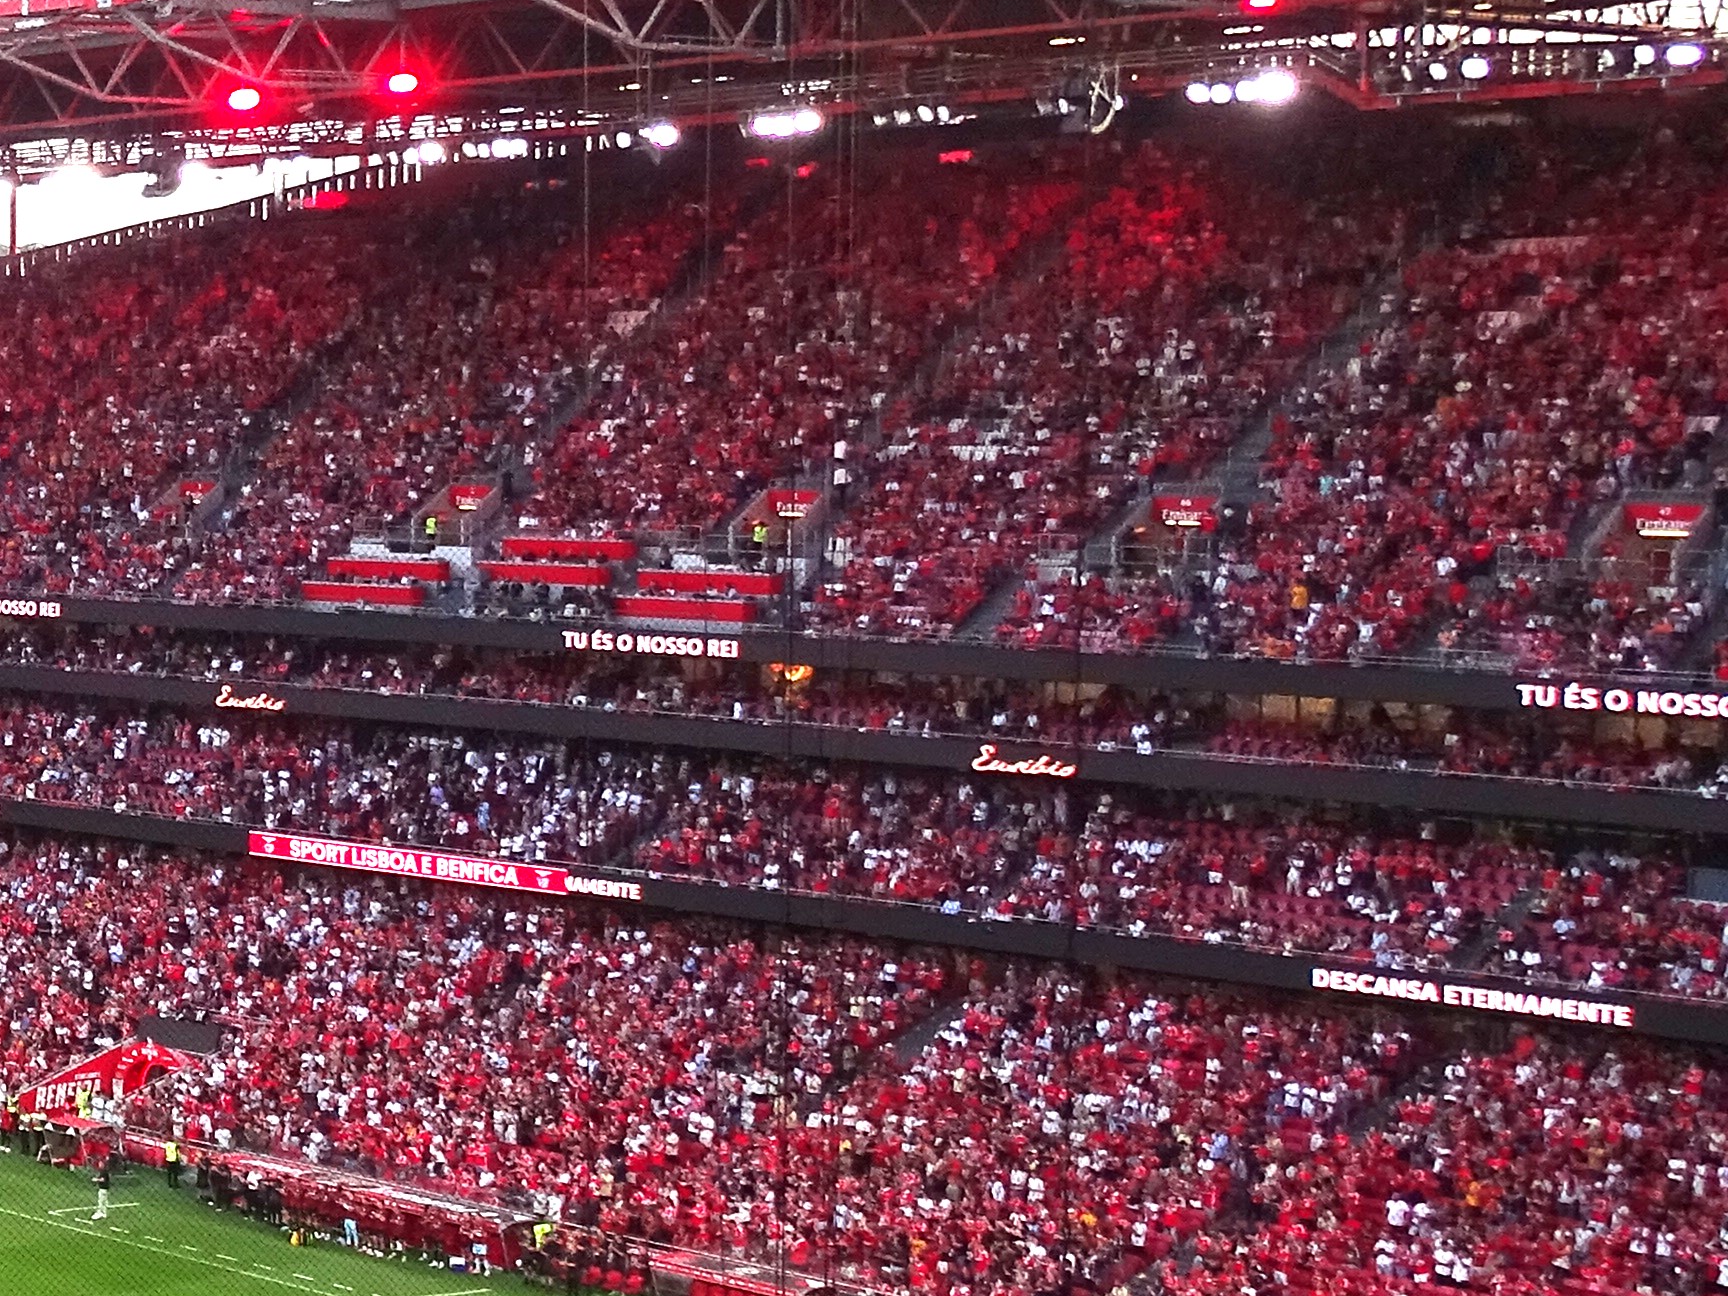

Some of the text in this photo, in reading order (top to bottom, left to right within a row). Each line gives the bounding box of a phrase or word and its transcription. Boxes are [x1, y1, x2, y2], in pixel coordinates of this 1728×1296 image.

[39, 602, 61, 617] REI
[562, 630, 589, 649] TU
[616, 633, 633, 652] O
[637, 634, 704, 656] NOSSO
[707, 638, 739, 658] REI
[1516, 683, 1557, 707] TU
[1563, 682, 1600, 710] ÉS
[1604, 689, 1631, 712] O
[288, 839, 519, 886] SPORT LISBOA E BENFICA
[1311, 968, 1634, 1027] DESCANSA ETERNAMENTE
